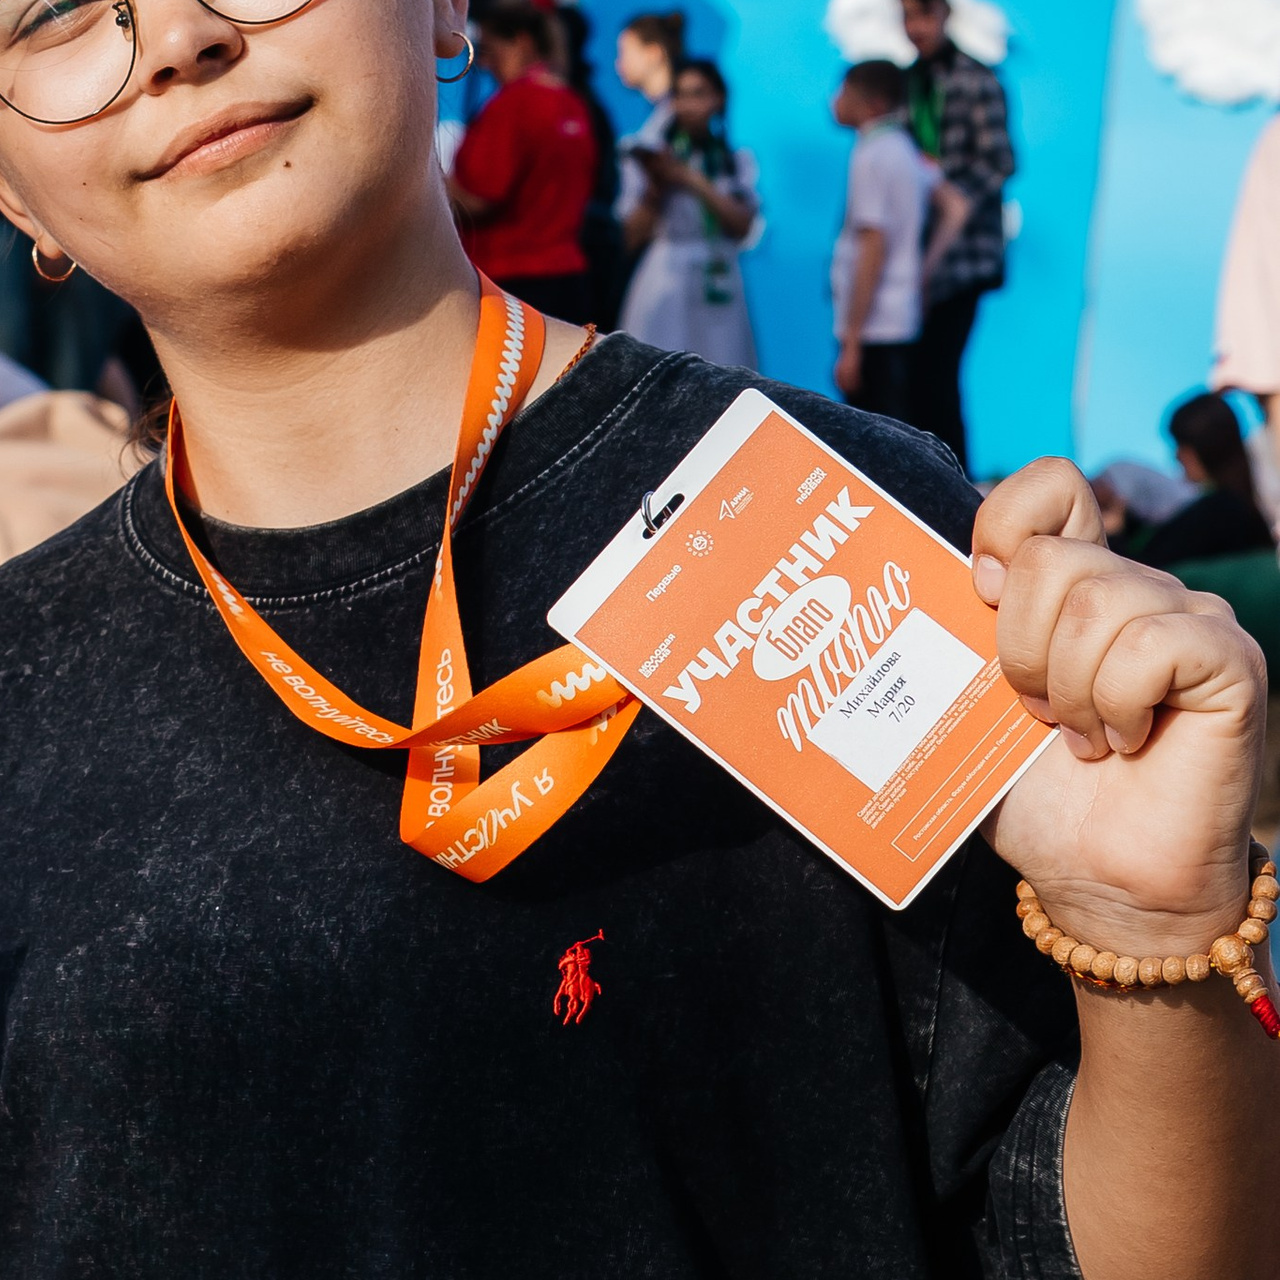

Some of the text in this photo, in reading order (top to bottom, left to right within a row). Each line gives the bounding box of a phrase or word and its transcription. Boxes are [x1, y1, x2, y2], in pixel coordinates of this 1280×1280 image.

[728, 485, 750, 509] АРМИ
[794, 468, 828, 506] первых
[795, 465, 823, 494] герои
[644, 561, 685, 604] Первые
[663, 486, 875, 714] УЧАСТНИК
[770, 600, 833, 661] благо
[636, 631, 677, 675] молодая
[642, 647, 672, 679] волна
[260, 651, 395, 744] не волнуйтесь
[837, 647, 903, 720] Михайлова
[866, 673, 910, 720] Мария
[887, 692, 918, 724] 7/20
[427, 648, 462, 818] волнутесь
